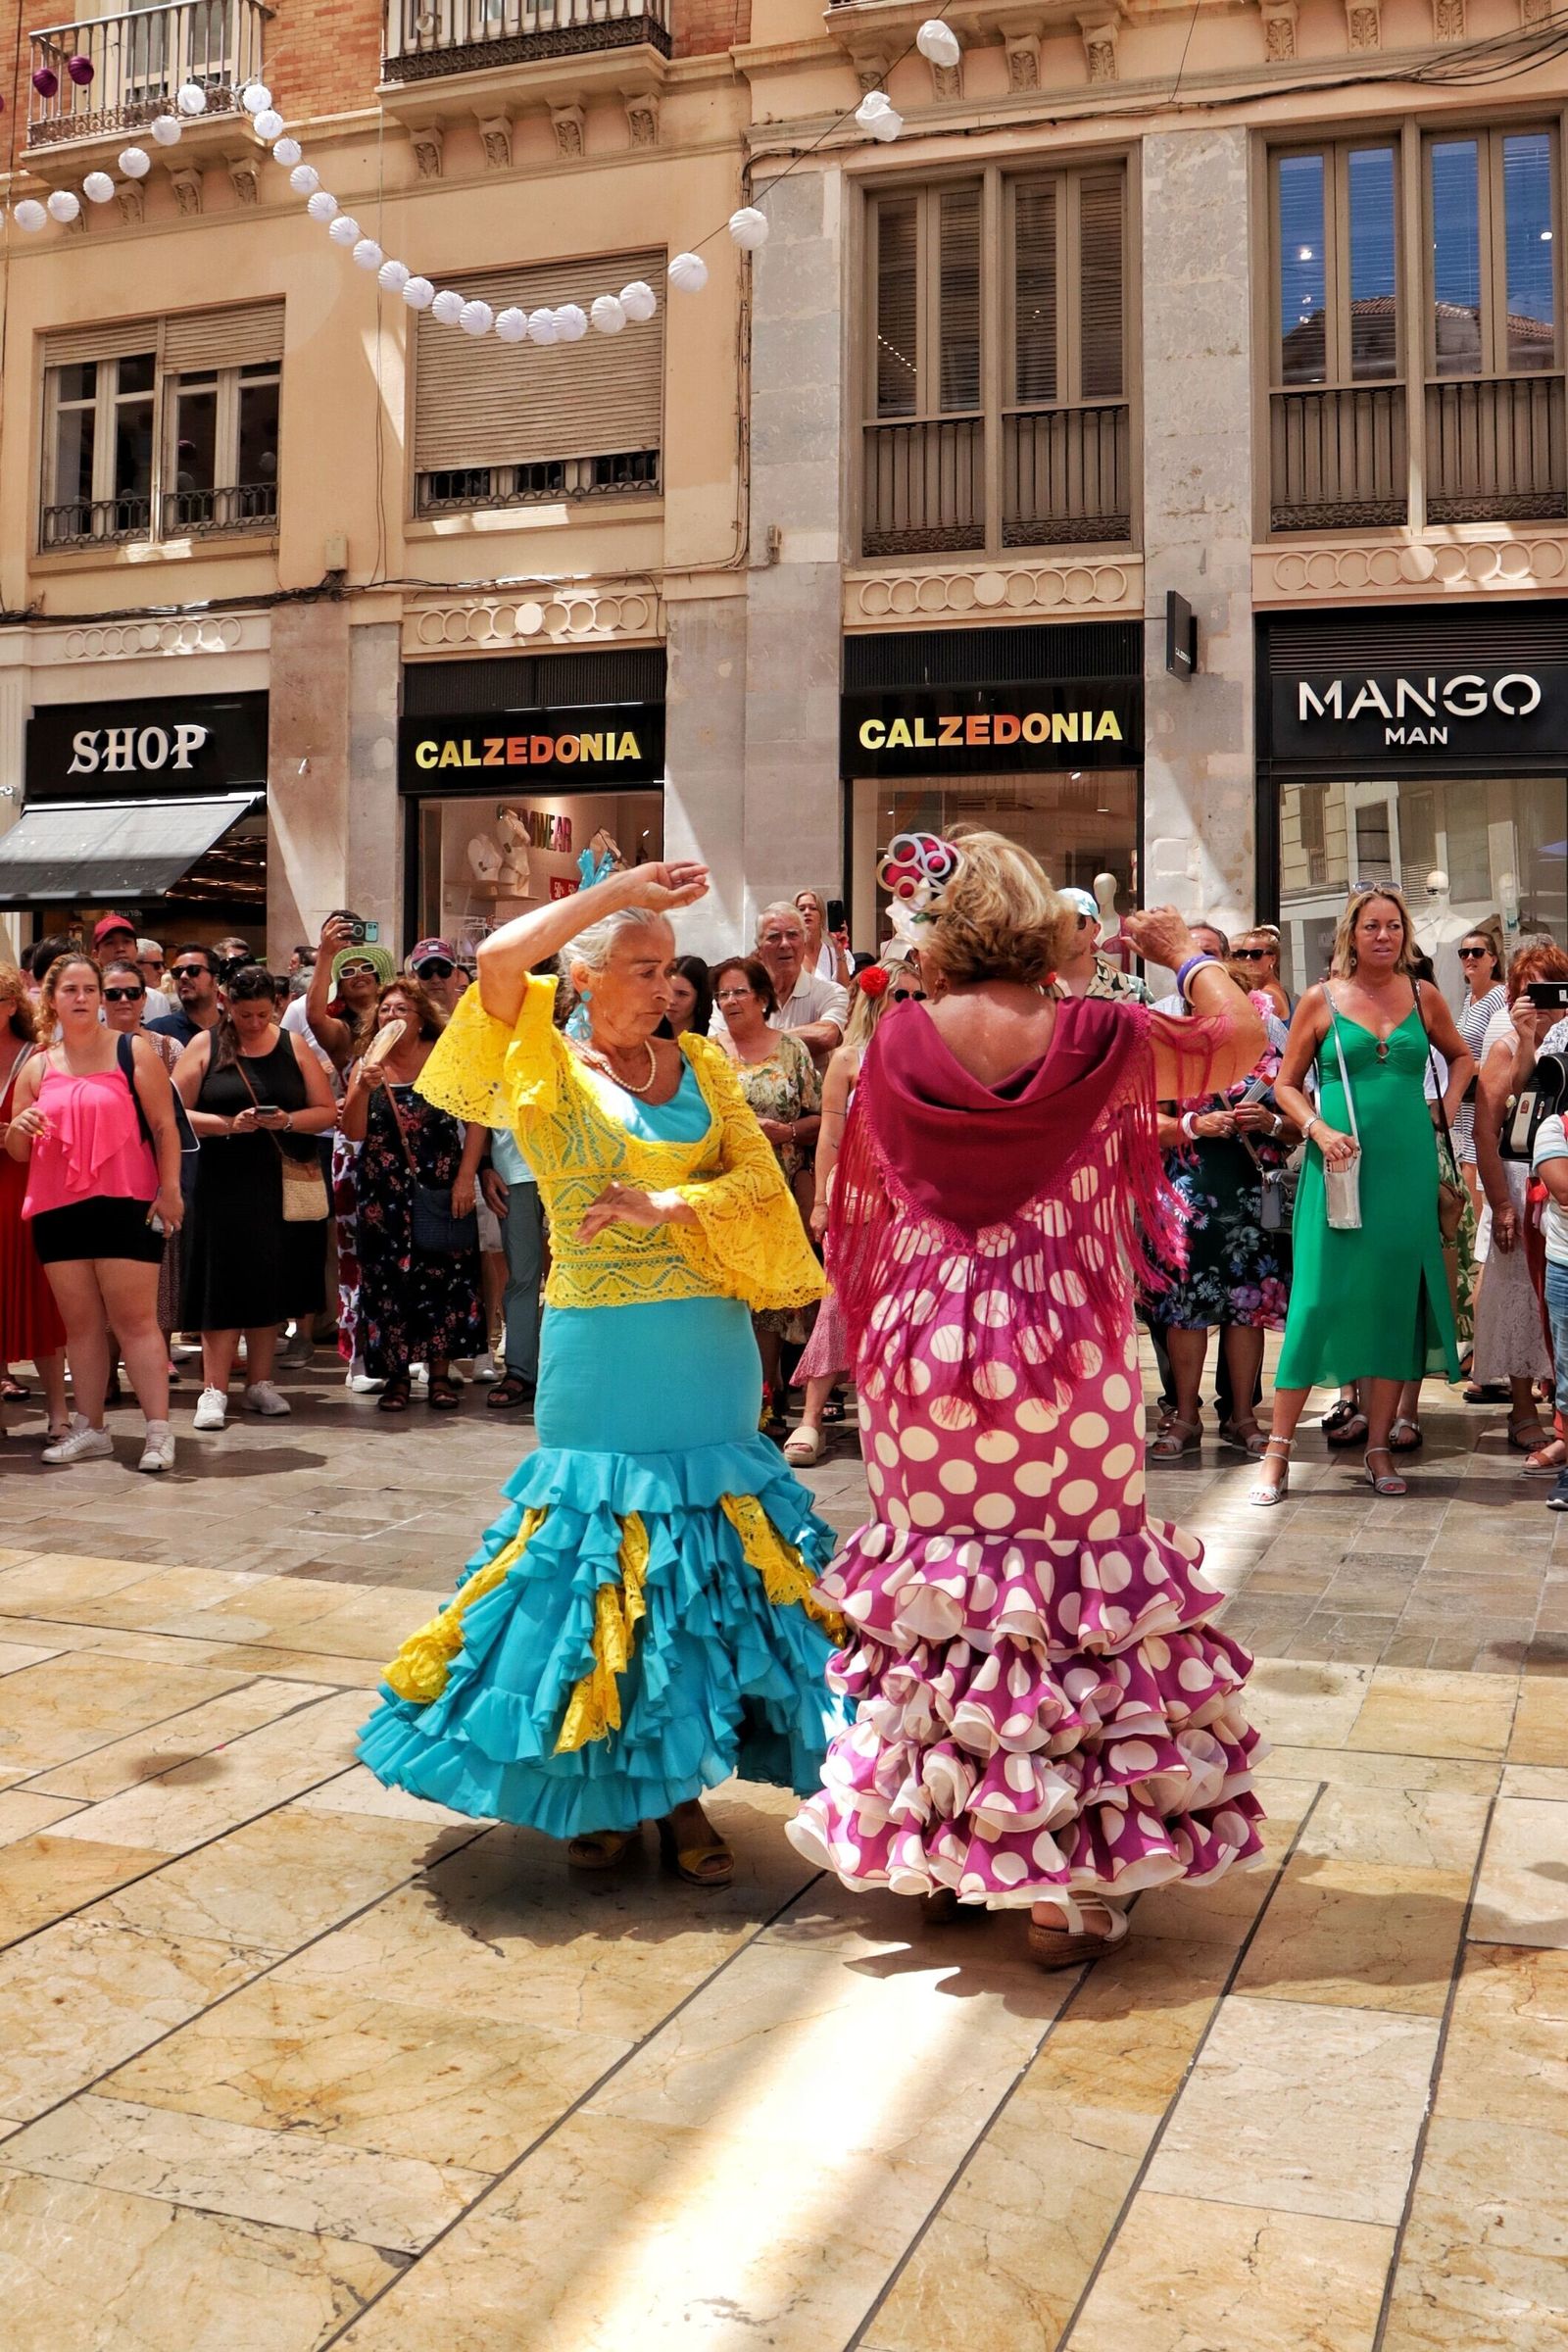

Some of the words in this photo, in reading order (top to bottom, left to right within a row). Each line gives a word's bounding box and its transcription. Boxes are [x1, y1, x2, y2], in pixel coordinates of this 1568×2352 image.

[1298, 673, 1542, 720] MANGO
[67, 724, 209, 774] SHOP
[415, 731, 642, 769] CALZEDONIA
[858, 710, 1123, 750] CALZEDONIA
[1385, 726, 1447, 745] MAN
